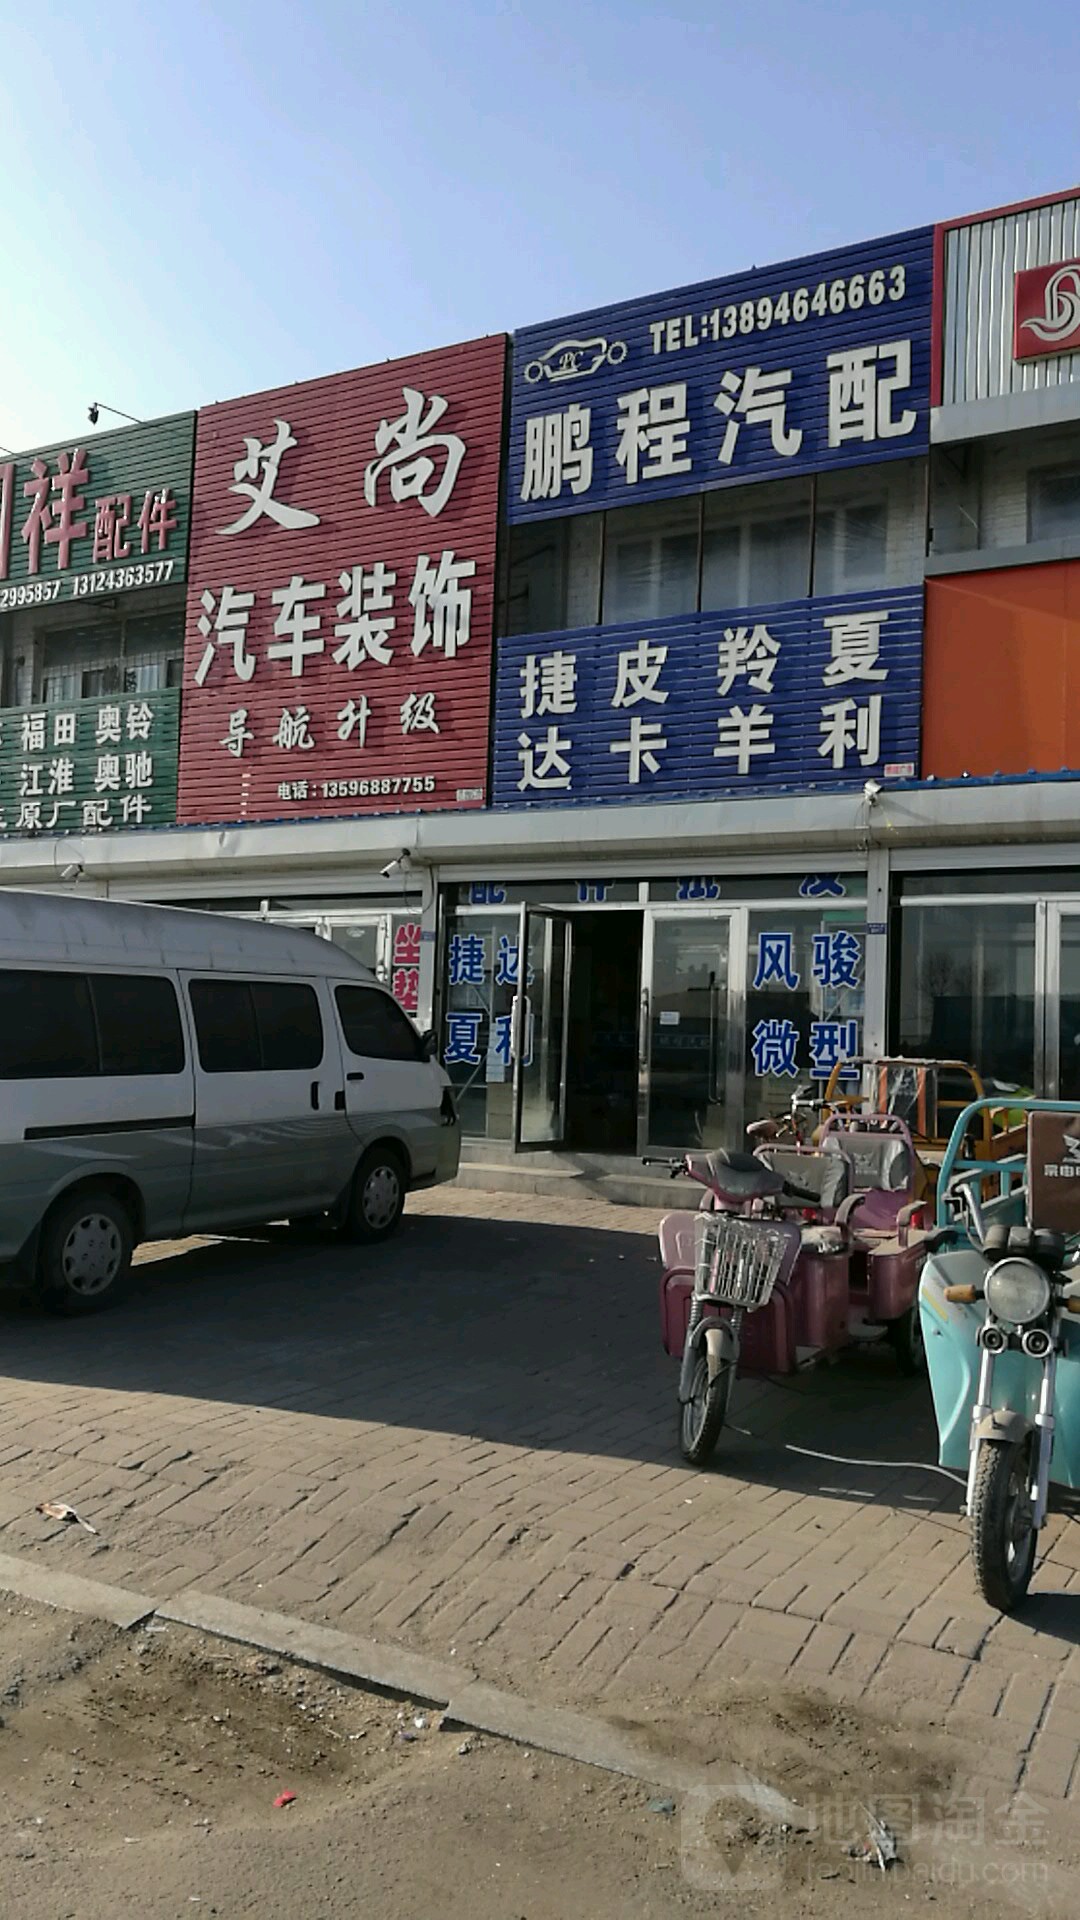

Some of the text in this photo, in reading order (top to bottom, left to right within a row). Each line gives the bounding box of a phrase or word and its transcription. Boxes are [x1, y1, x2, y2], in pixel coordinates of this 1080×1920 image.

[649, 265, 907, 355] TEL:13894646663
[216, 387, 467, 535] 艾尚
[519, 339, 917, 501] 鹏程汽配
[0, 448, 177, 579] 祥配件
[73, 560, 174, 596] 13124363577
[193, 550, 477, 686] 汽车装饰
[21, 712, 76, 751] 福田
[95, 702, 154, 744] 奥铃
[219, 692, 441, 758] 导航升级
[517, 650, 579, 792] 捷达
[610, 639, 669, 784] 皮卡
[816, 610, 889, 769] 夏利
[0, 793, 152, 830] 原厂配件
[19, 750, 153, 796] 江淮 奥驰
[392, 922, 422, 1013] 坐垫
[449, 934, 535, 986] 捷达
[753, 931, 861, 991] 风骏
[752, 1019, 861, 1081] 微型
